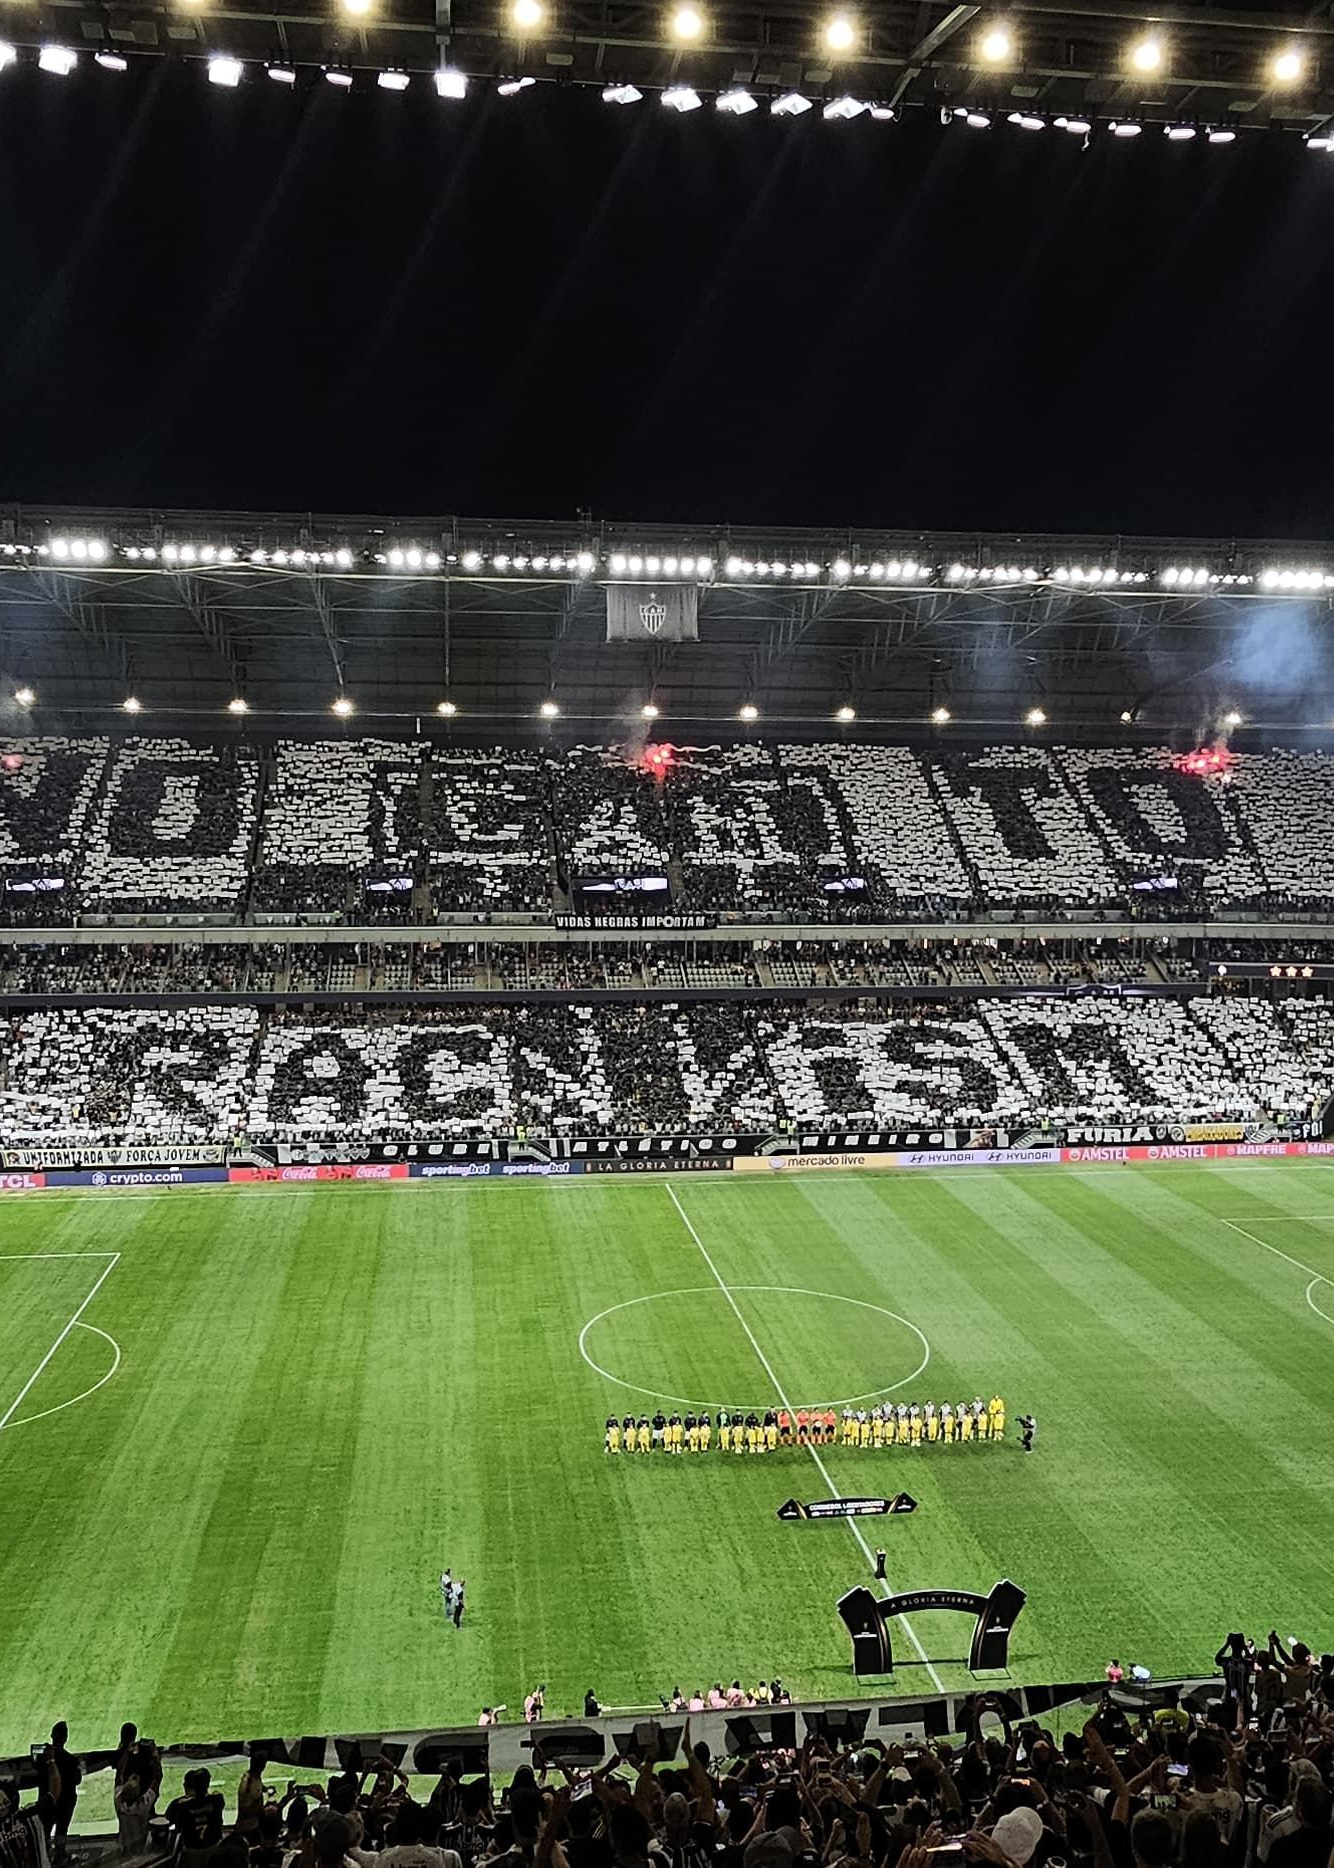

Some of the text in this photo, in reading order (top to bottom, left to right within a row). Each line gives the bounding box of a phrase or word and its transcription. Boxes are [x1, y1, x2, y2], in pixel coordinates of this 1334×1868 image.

[970, 764, 1234, 860] TO
[557, 916, 705, 928] VIDAS NEGRAS IMPORTAM
[1067, 1127, 1155, 1142] FURIA
[1082, 1147, 1129, 1160] AMSTEL
[1160, 1145, 1207, 1158] AMSTEL
[1237, 1143, 1287, 1155] MAPFRE
[23, 1148, 201, 1164] UNIFORMIZADA FORÇA JOVEM
[788, 1155, 865, 1166] mercado livre
[928, 1154, 974, 1162] HYUNDAI
[1006, 1152, 1052, 1160] HYUNDAI
[422, 1164, 491, 1177] sportingbet
[502, 1162, 571, 1175] sportingbet
[598, 1160, 719, 1171] LA GLORIA ETERNA
[110, 1171, 183, 1184] crypto.com
[941, 1596, 975, 1605] ETERNA
